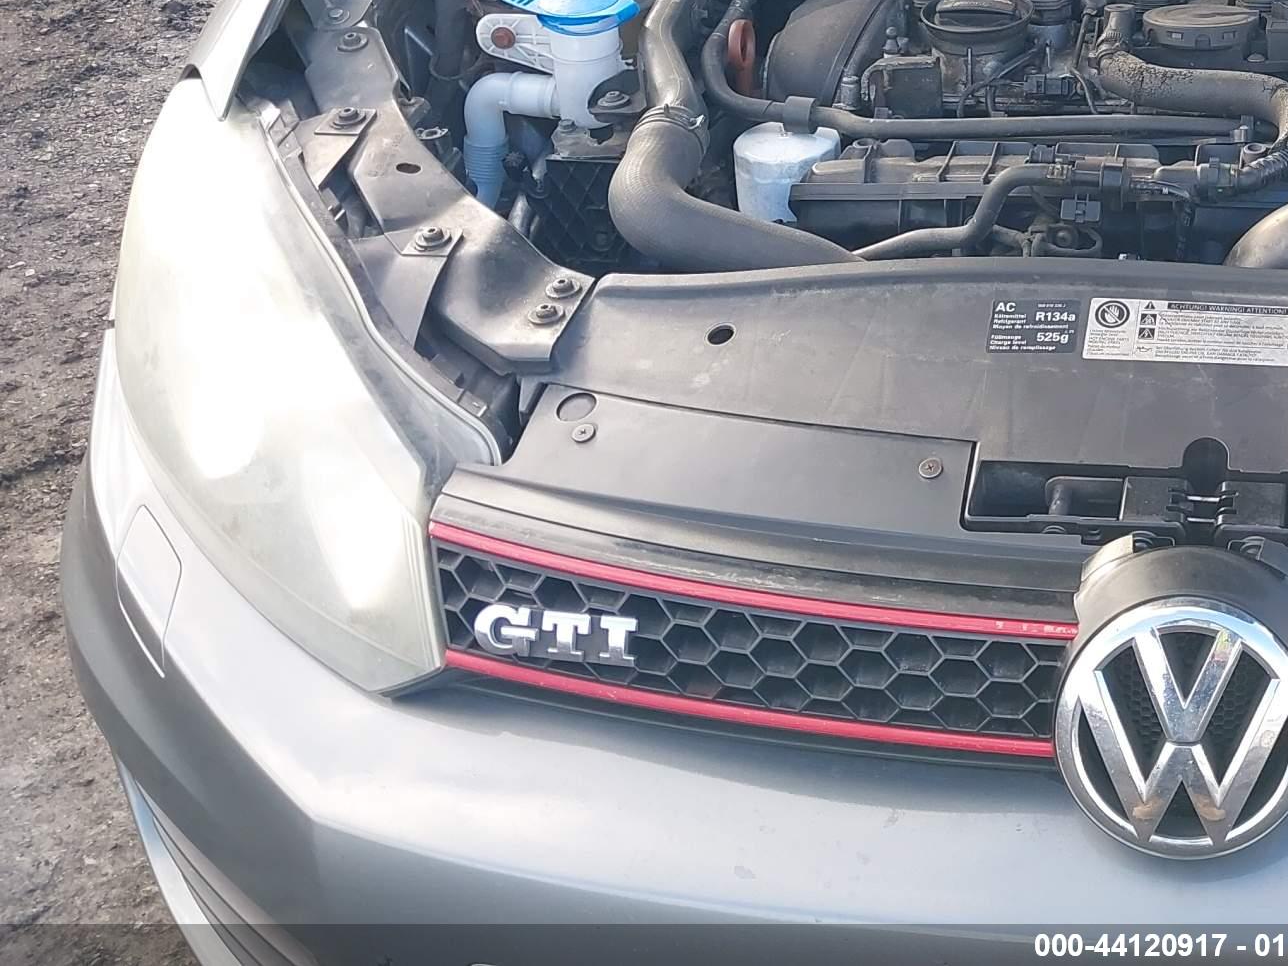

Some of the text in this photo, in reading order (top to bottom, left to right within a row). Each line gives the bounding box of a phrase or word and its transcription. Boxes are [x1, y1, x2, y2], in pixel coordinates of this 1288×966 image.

[995, 302, 1016, 312] AC
[1209, 305, 1245, 313] WARNING!
[1246, 307, 1287, 315] ATTENTION!
[1035, 311, 1076, 322] R134a
[1036, 332, 1069, 344] 525g
[473, 603, 640, 666] GTI
